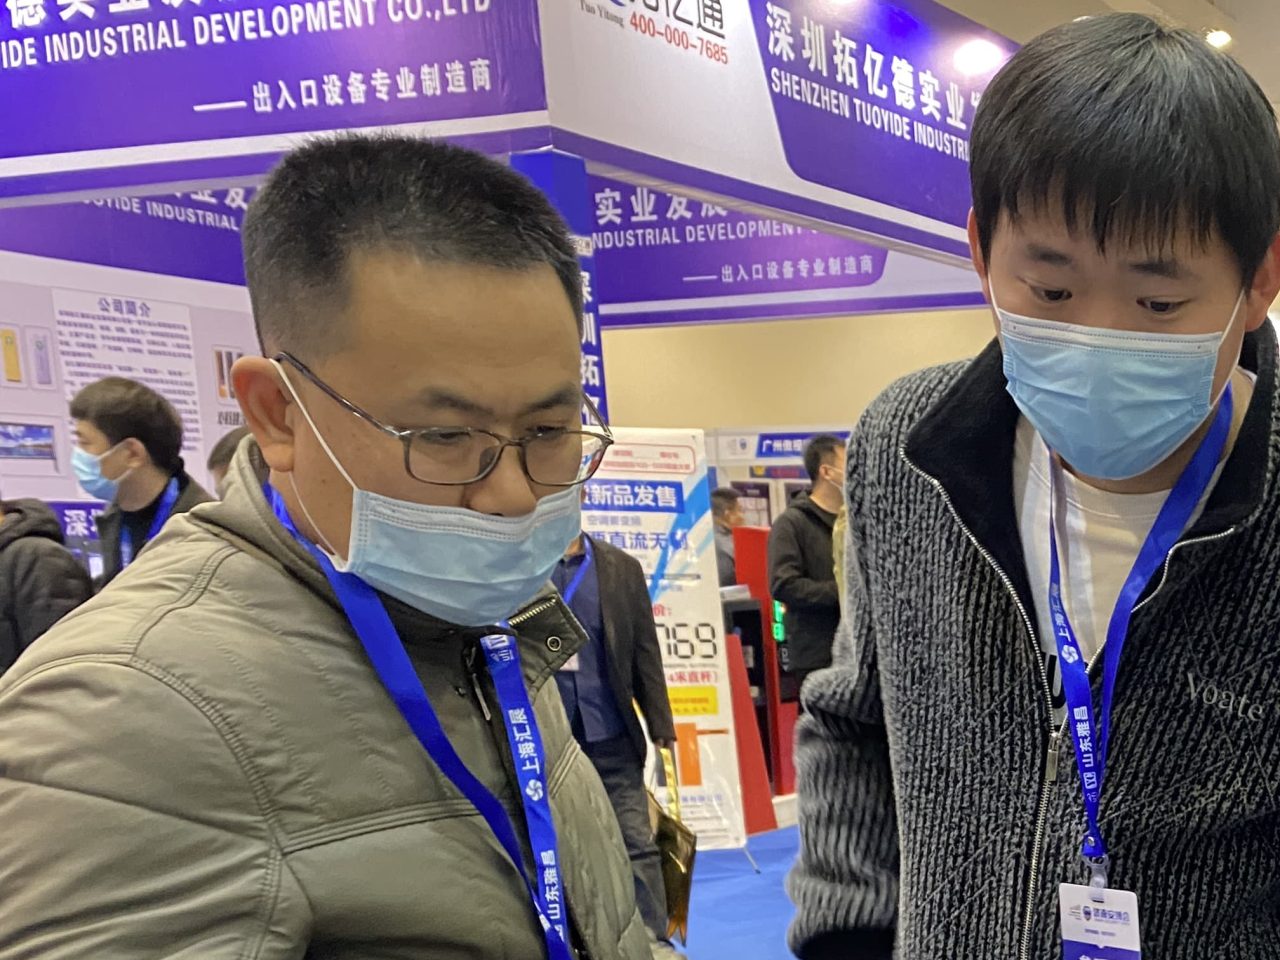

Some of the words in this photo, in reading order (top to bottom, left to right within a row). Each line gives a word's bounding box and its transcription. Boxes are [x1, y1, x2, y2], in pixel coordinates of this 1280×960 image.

[44, 19, 187, 63] INDUSTRIAL
[193, 0, 377, 45] DEVELOPMENT
[630, 11, 729, 65] 400-000-7685
[253, 57, 492, 113] 出入口设备专业制造商
[766, 1, 982, 130] 深圳拓亿德实业
[770, 66, 850, 119] SHENZHEN
[853, 97, 911, 141] TUOYIDE
[147, 200, 239, 231] INDUSTRIAL
[720, 254, 874, 283] 出入口设备专业制造商
[508, 707, 541, 775] 上海汇展
[1073, 705, 1095, 769] 山东雅昌
[541, 848, 560, 921] 山东雅昌
